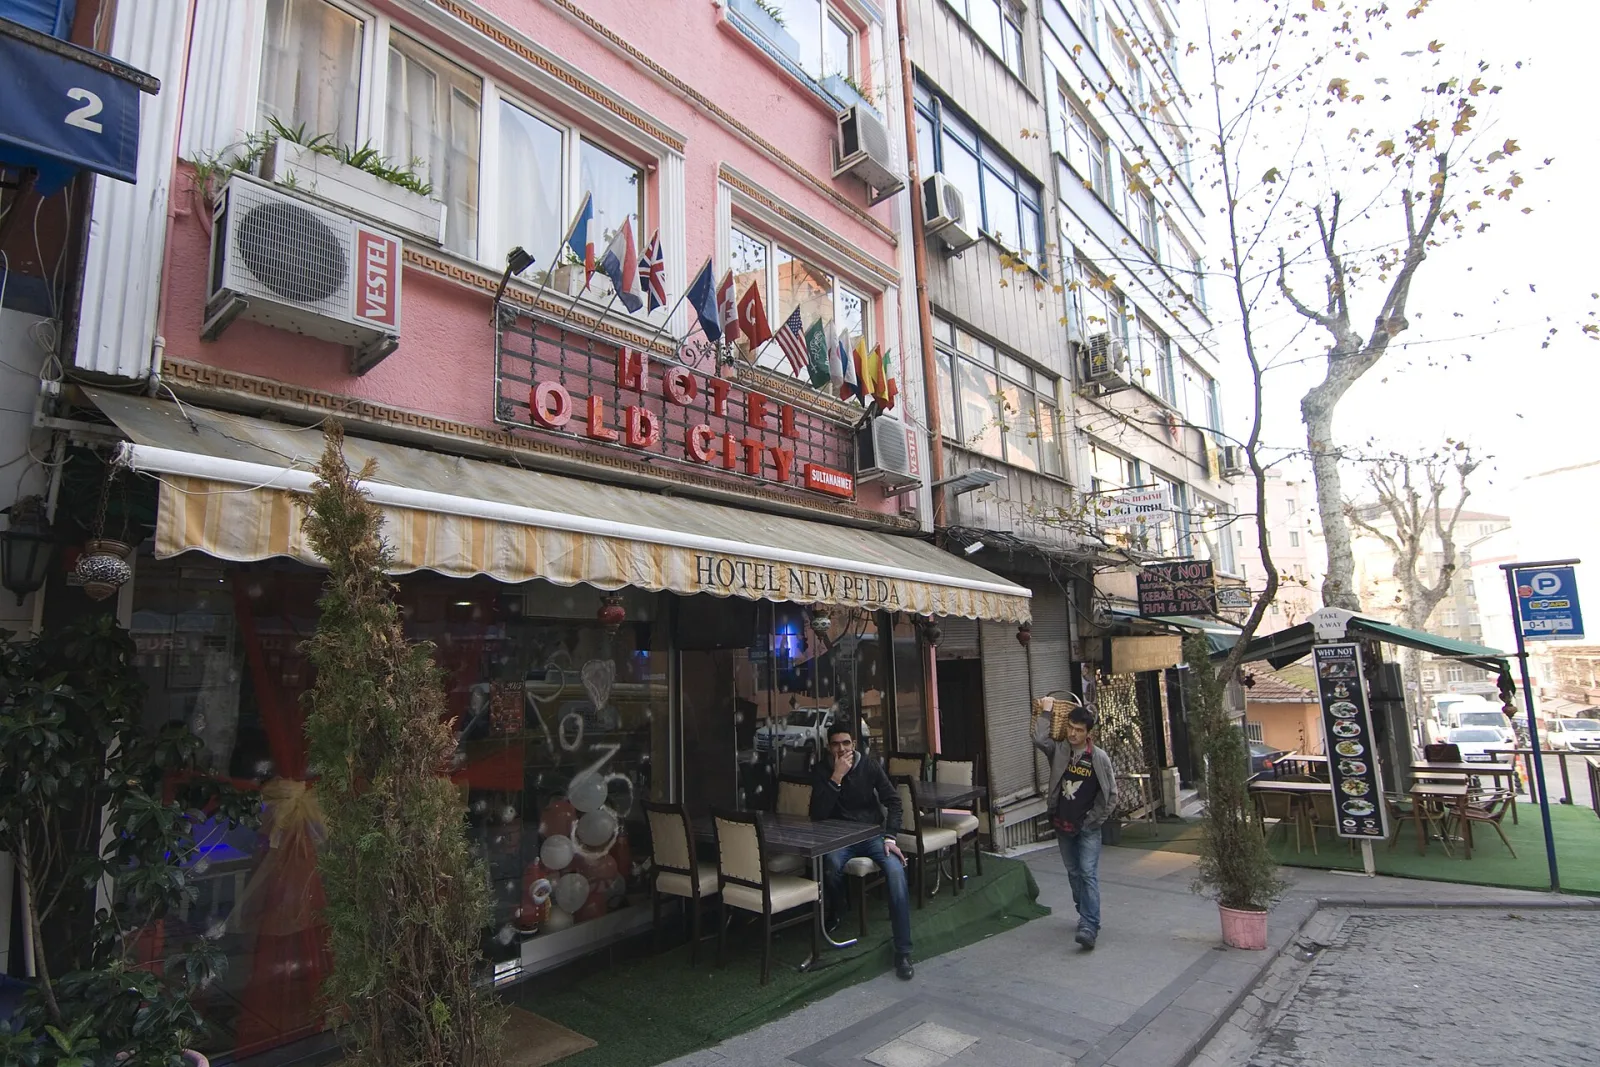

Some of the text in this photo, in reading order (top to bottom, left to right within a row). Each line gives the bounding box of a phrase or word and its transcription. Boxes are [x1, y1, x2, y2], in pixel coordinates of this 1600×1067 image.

[64, 87, 103, 134] 2
[365, 237, 389, 319] VESTEL
[618, 346, 800, 439] HOTEL
[529, 380, 660, 448] OLD
[907, 431, 918, 473] VESTEL
[811, 468, 852, 491] SULTANAHMET
[694, 555, 900, 605] HOTEL NEW PELDA
[1178, 563, 1209, 580] NOT
[1538, 578, 1556, 590] P
[1141, 590, 1174, 602] KEBAB
[1168, 602, 1177, 612] &
